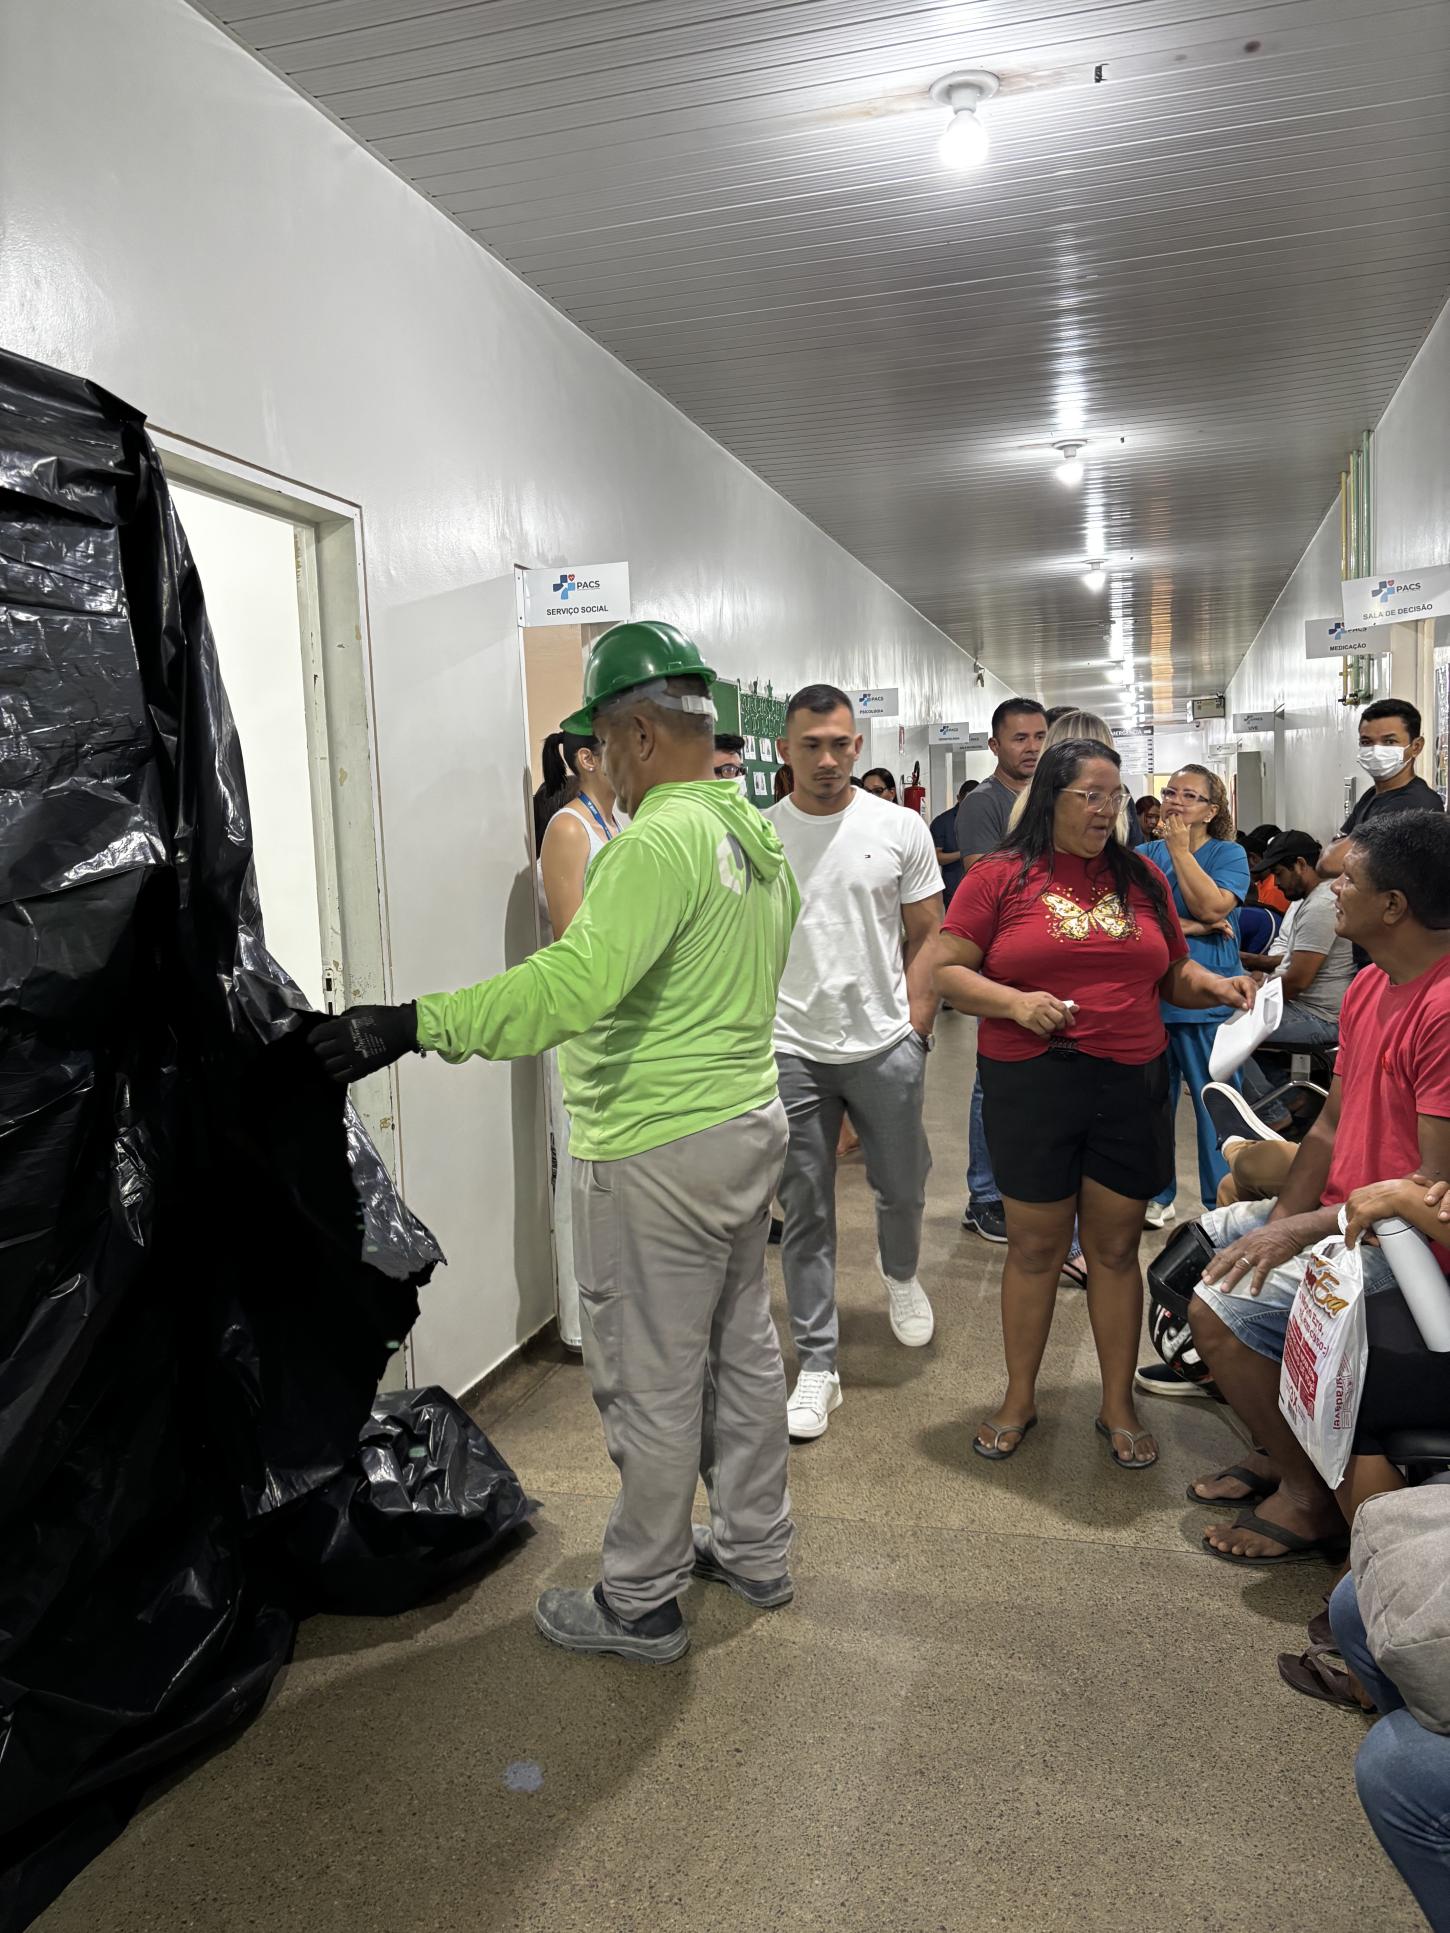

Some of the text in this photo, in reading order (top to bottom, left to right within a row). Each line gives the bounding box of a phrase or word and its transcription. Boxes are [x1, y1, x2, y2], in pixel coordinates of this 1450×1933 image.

[576, 580, 600, 590] PACS
[1396, 582, 1421, 593] PACS
[546, 605, 608, 616] SERVIÇO SOCIAL
[1362, 603, 1433, 620] SALA DE DECISÃO
[1329, 642, 1367, 652] MEDICAÇÃO
